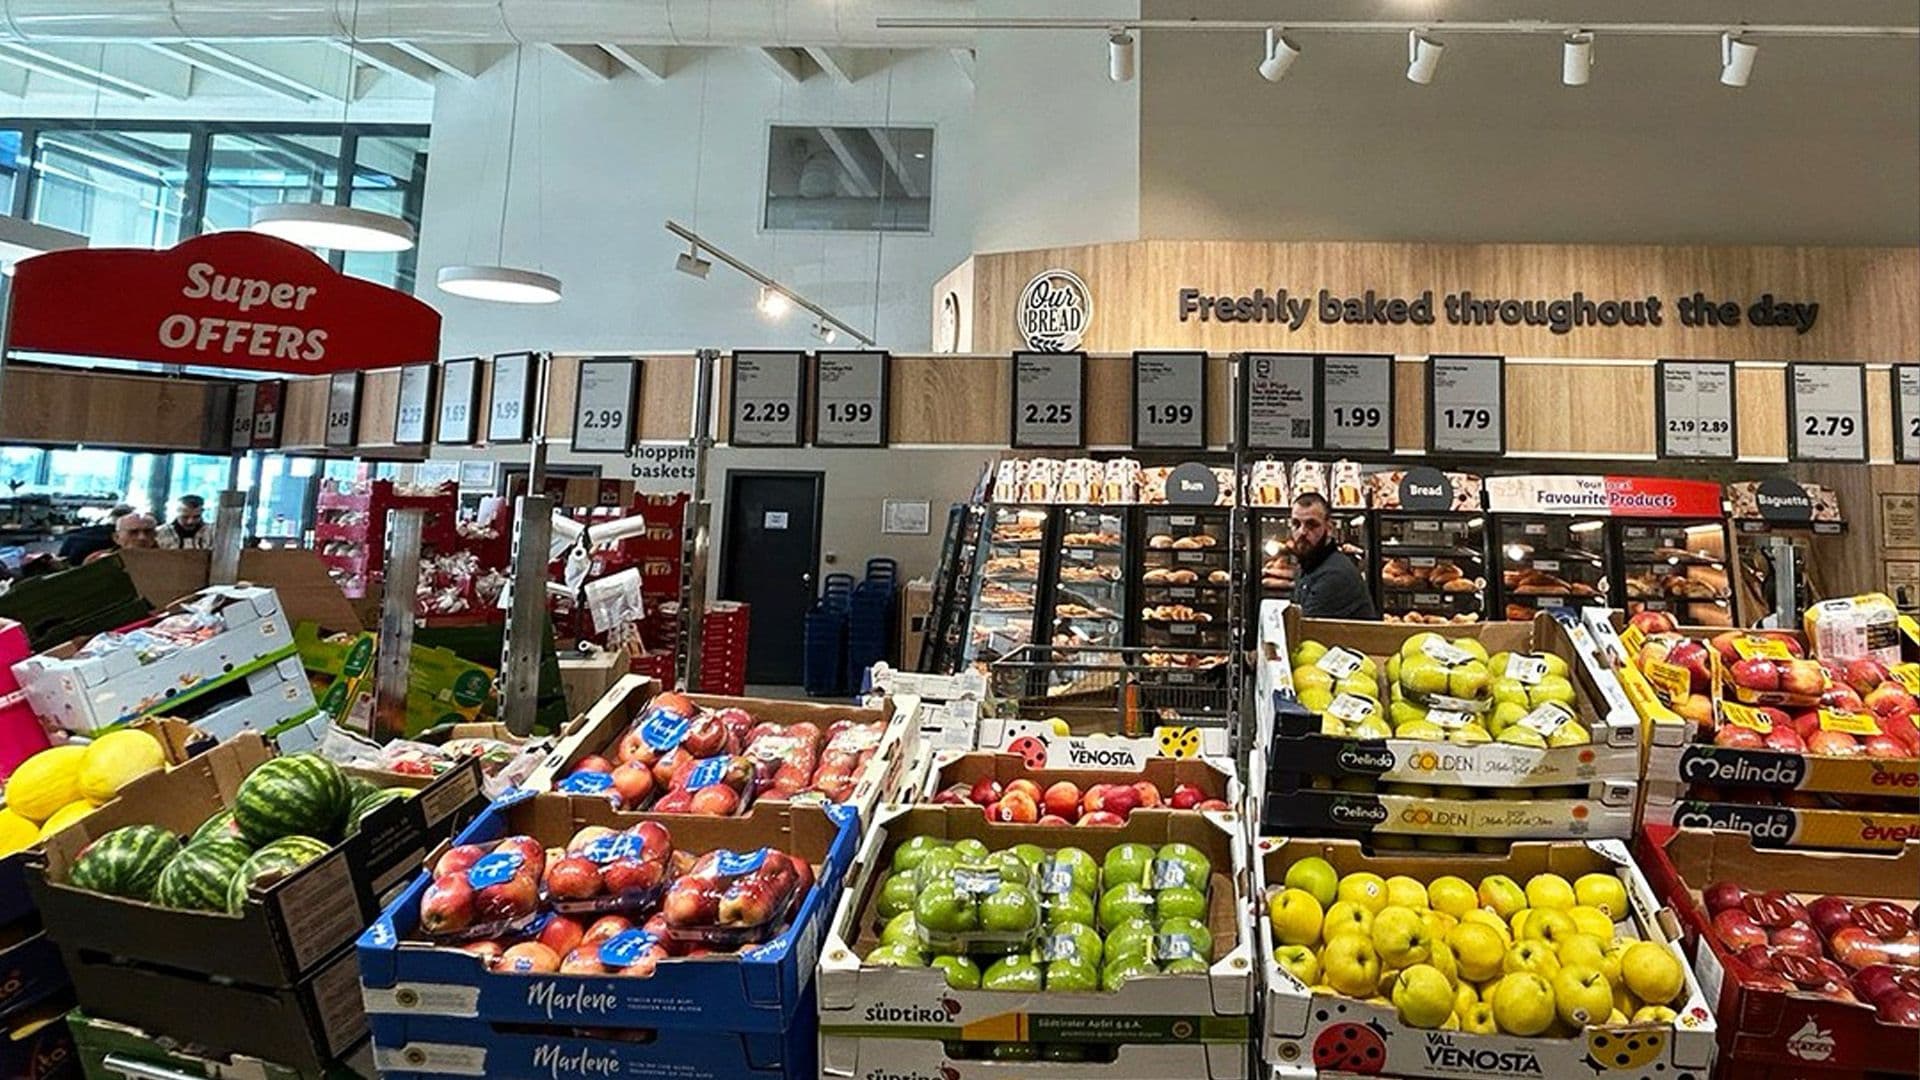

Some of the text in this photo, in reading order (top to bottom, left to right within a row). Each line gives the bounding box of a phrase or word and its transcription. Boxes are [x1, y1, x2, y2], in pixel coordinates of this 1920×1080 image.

[183, 262, 318, 312] Super
[1030, 279, 1075, 309] Our
[1178, 287, 1820, 335] Freshly baked throughout the day
[1027, 309, 1082, 334] BREAD
[158, 313, 329, 361] OFFERS
[330, 411, 350, 428] 2.49
[495, 401, 520, 420] 1.99
[583, 409, 623, 429] 2.99
[742, 402, 791, 422] 2.29
[826, 402, 873, 422] 1.99
[1025, 403, 1073, 424] 2.25
[1147, 404, 1194, 424] 1.99
[1333, 407, 1381, 428] 1.99
[1444, 409, 1491, 430] 1.79
[1669, 420, 1695, 433] 2.19
[1700, 420, 1729, 433] 2.89
[1804, 415, 1855, 437] 2.79
[631, 463, 696, 479] baskets
[1409, 484, 1443, 496] Bread
[1576, 479, 1602, 489] Your
[1536, 490, 1676, 508] Favourite Products
[1757, 494, 1809, 508] Baguette
[1068, 749, 1136, 766] VENOSTA
[1341, 752, 1393, 767] Melinda
[1407, 752, 1474, 773] GOLDEN
[1685, 756, 1798, 784] Melinda
[1332, 805, 1386, 819] Melinda
[1401, 807, 1468, 828] GOLDEN
[527, 981, 618, 1019] Marlene
[1425, 1032, 1455, 1047] VAL
[532, 1044, 620, 1080] Marlene
[1425, 1046, 1543, 1074] VENOSTA
